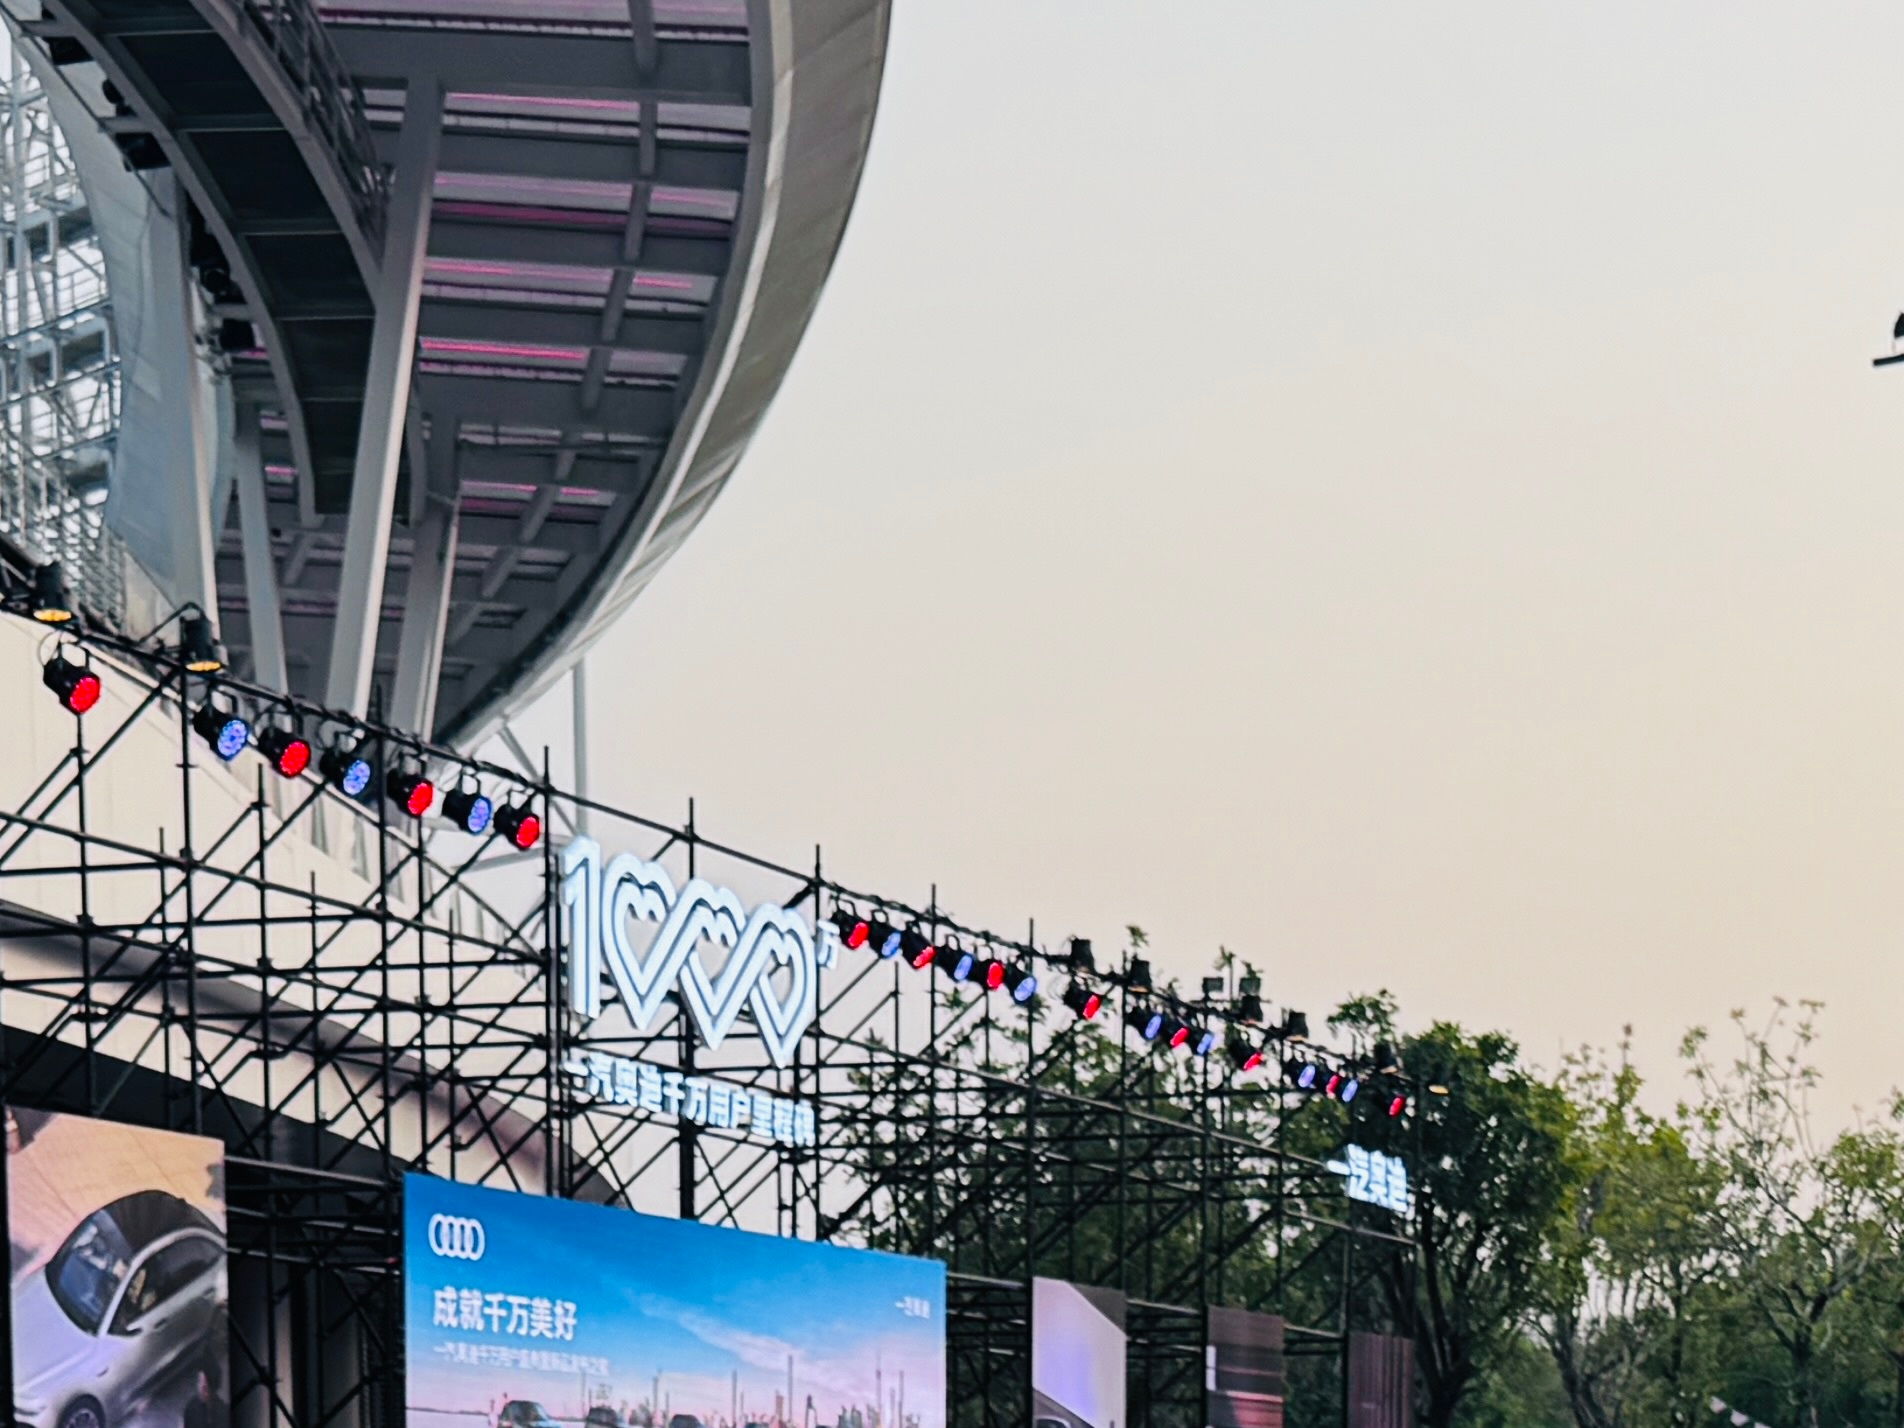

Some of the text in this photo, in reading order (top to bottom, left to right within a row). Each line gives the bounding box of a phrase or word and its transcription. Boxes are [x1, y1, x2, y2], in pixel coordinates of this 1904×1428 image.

[433, 1285, 577, 1341] 成就千万美好
